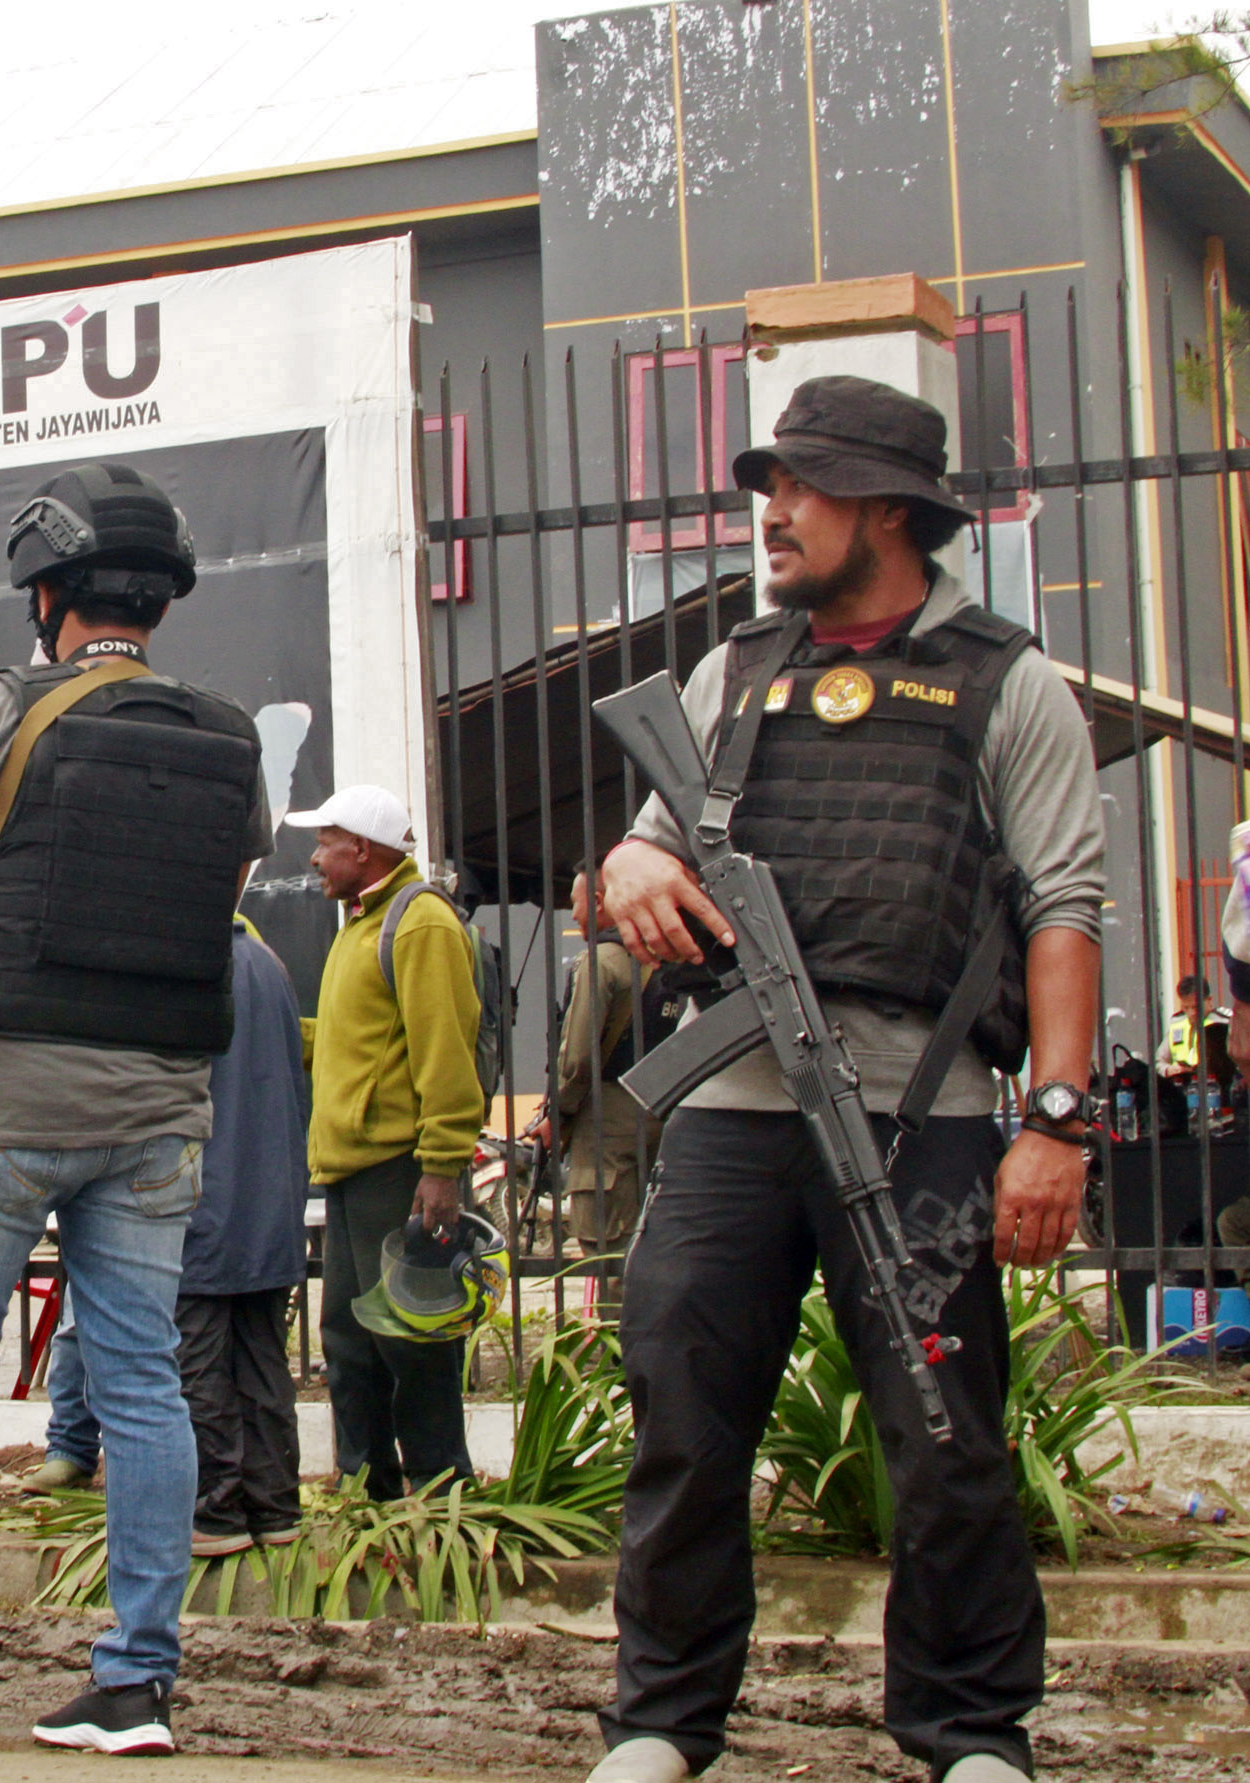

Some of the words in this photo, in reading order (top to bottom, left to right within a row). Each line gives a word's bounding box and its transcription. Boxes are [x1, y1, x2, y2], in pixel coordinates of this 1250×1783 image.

[36, 400, 162, 441] JAYAWIJAYA
[86, 640, 139, 656] SONY
[891, 679, 957, 706] POLISI
